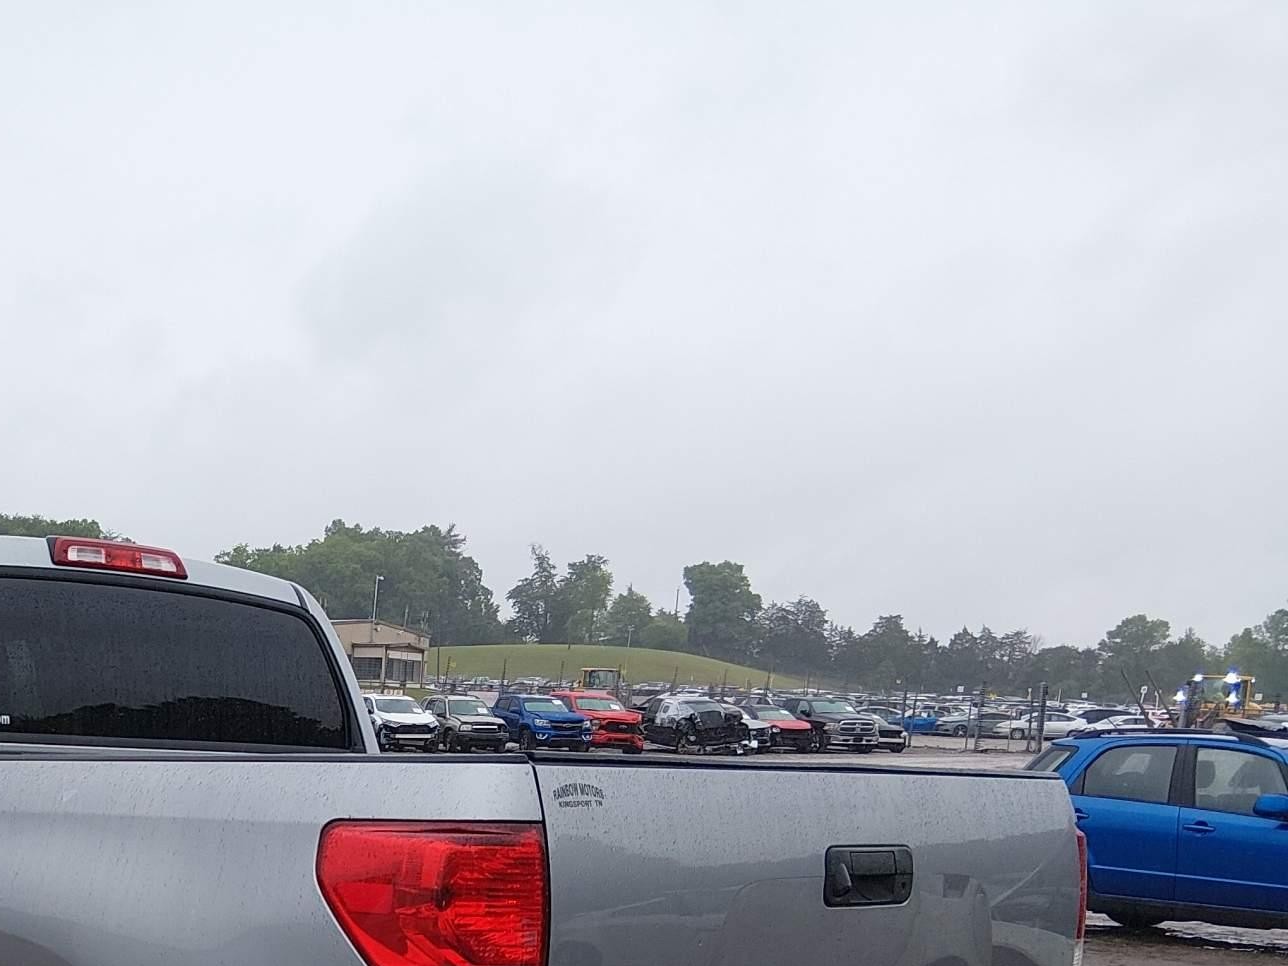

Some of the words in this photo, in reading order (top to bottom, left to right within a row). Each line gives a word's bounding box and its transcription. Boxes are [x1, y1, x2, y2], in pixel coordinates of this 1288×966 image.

[553, 783, 579, 801] RAINBOW
[579, 783, 605, 799] MOTORS
[558, 800, 592, 808] KINGSPORT
